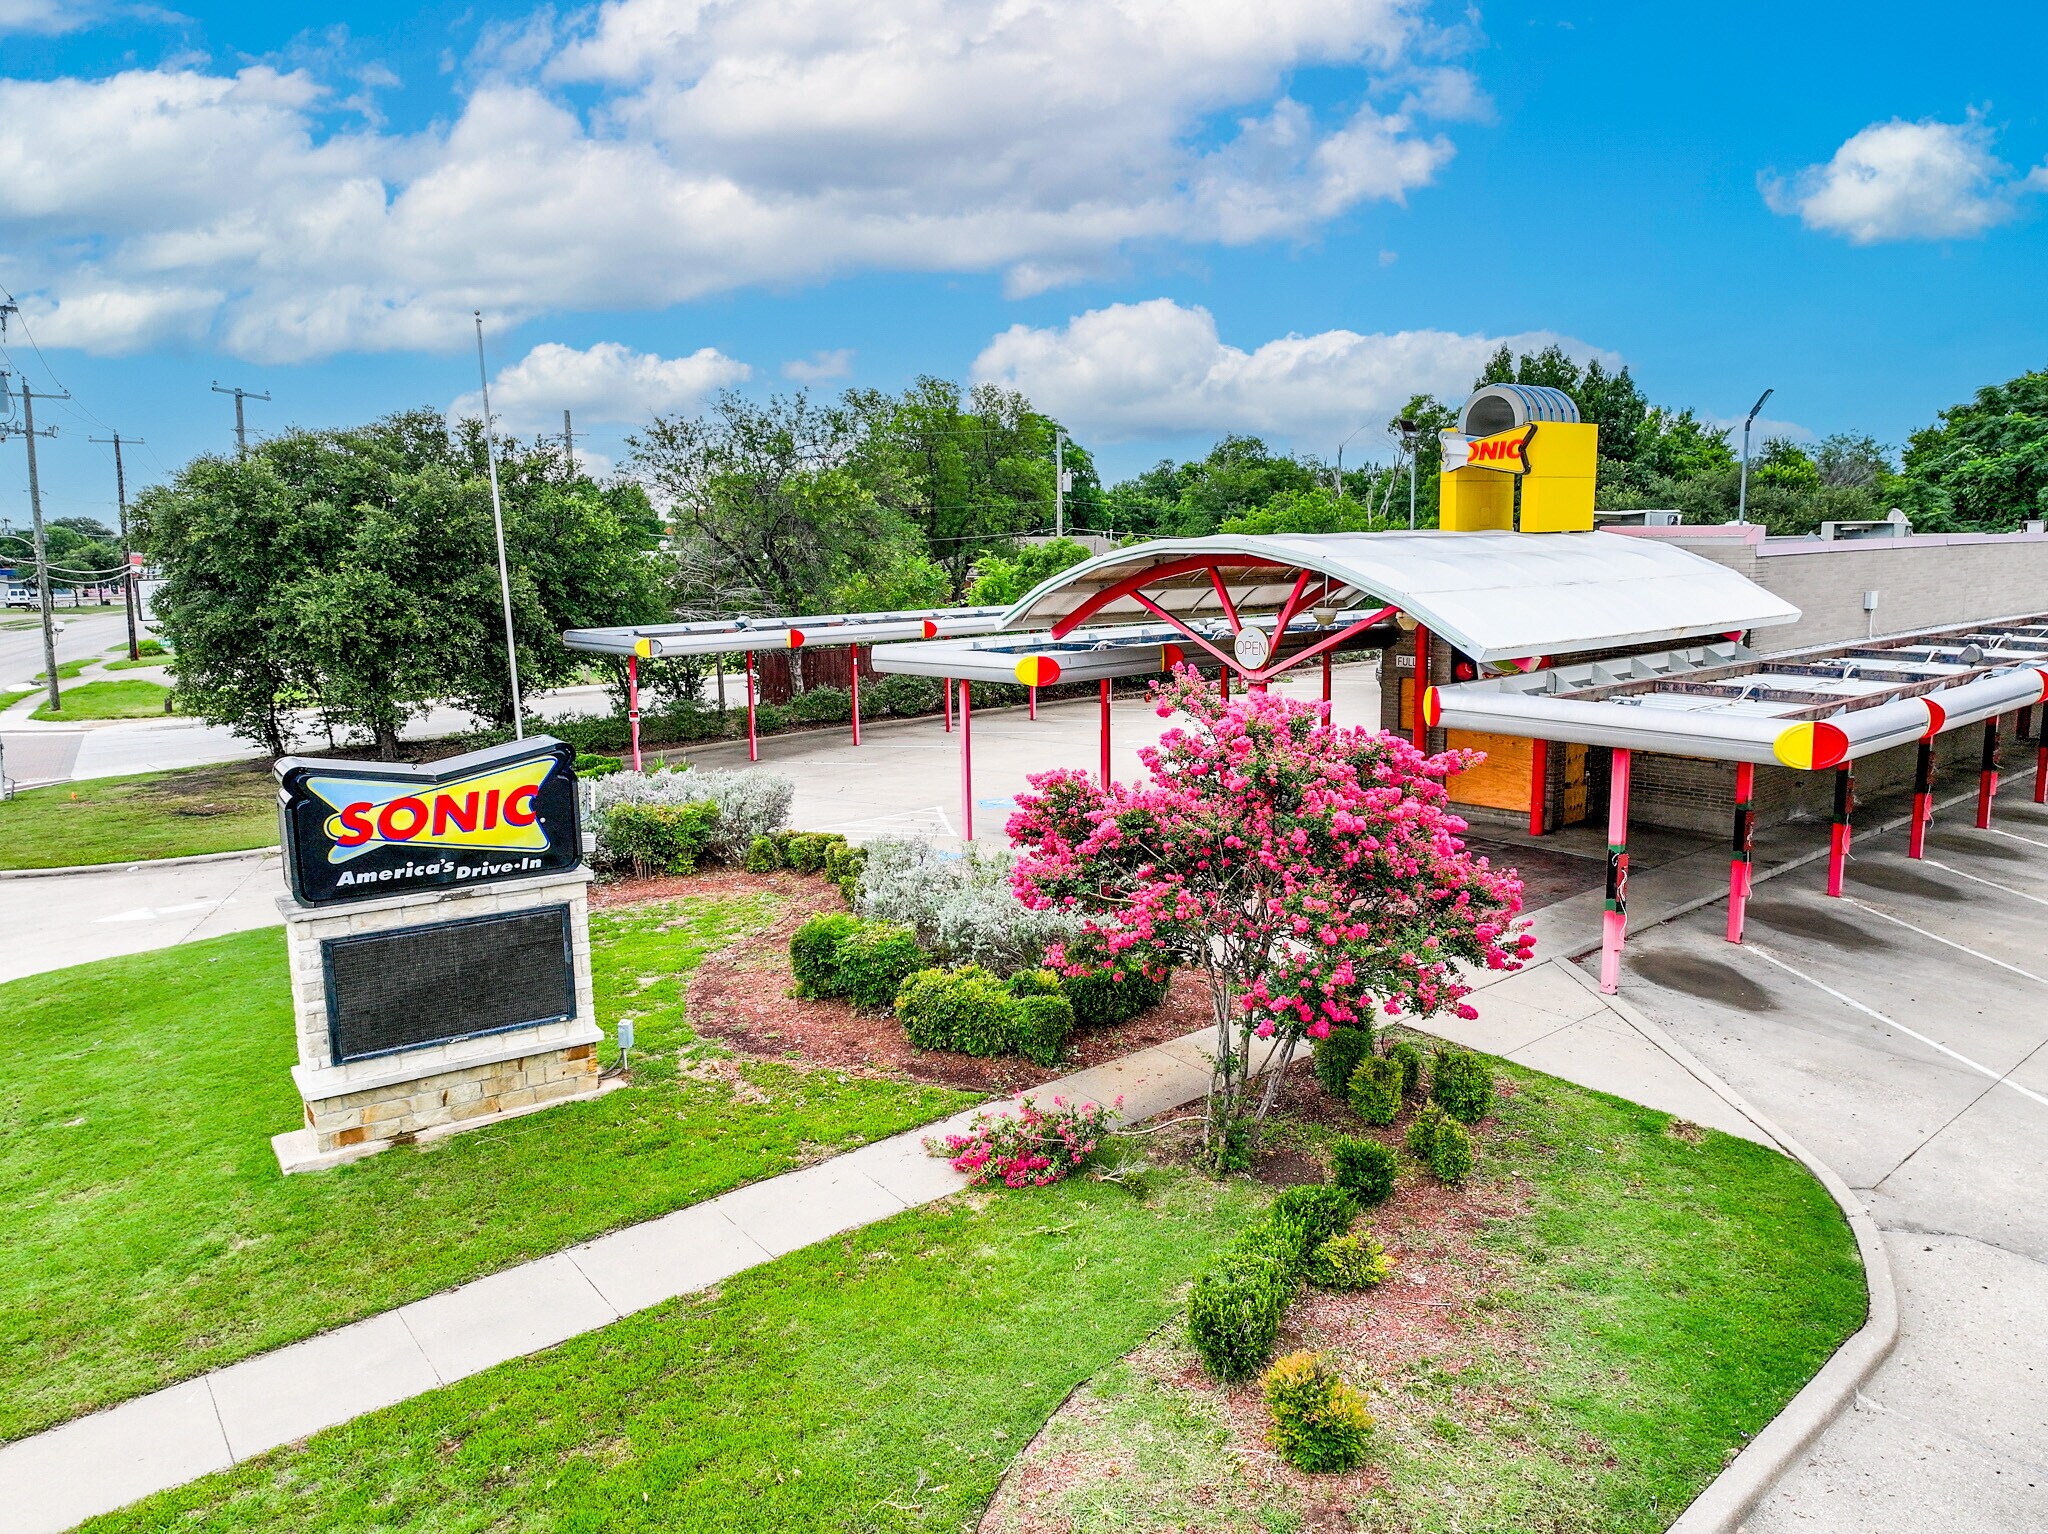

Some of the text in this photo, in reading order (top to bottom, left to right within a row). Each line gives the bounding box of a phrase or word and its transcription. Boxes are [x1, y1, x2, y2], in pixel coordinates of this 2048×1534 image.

[1467, 439, 1523, 462] ONIC
[1236, 641, 1267, 655] OPEN
[336, 785, 539, 848] SONIC
[336, 859, 455, 887] America's
